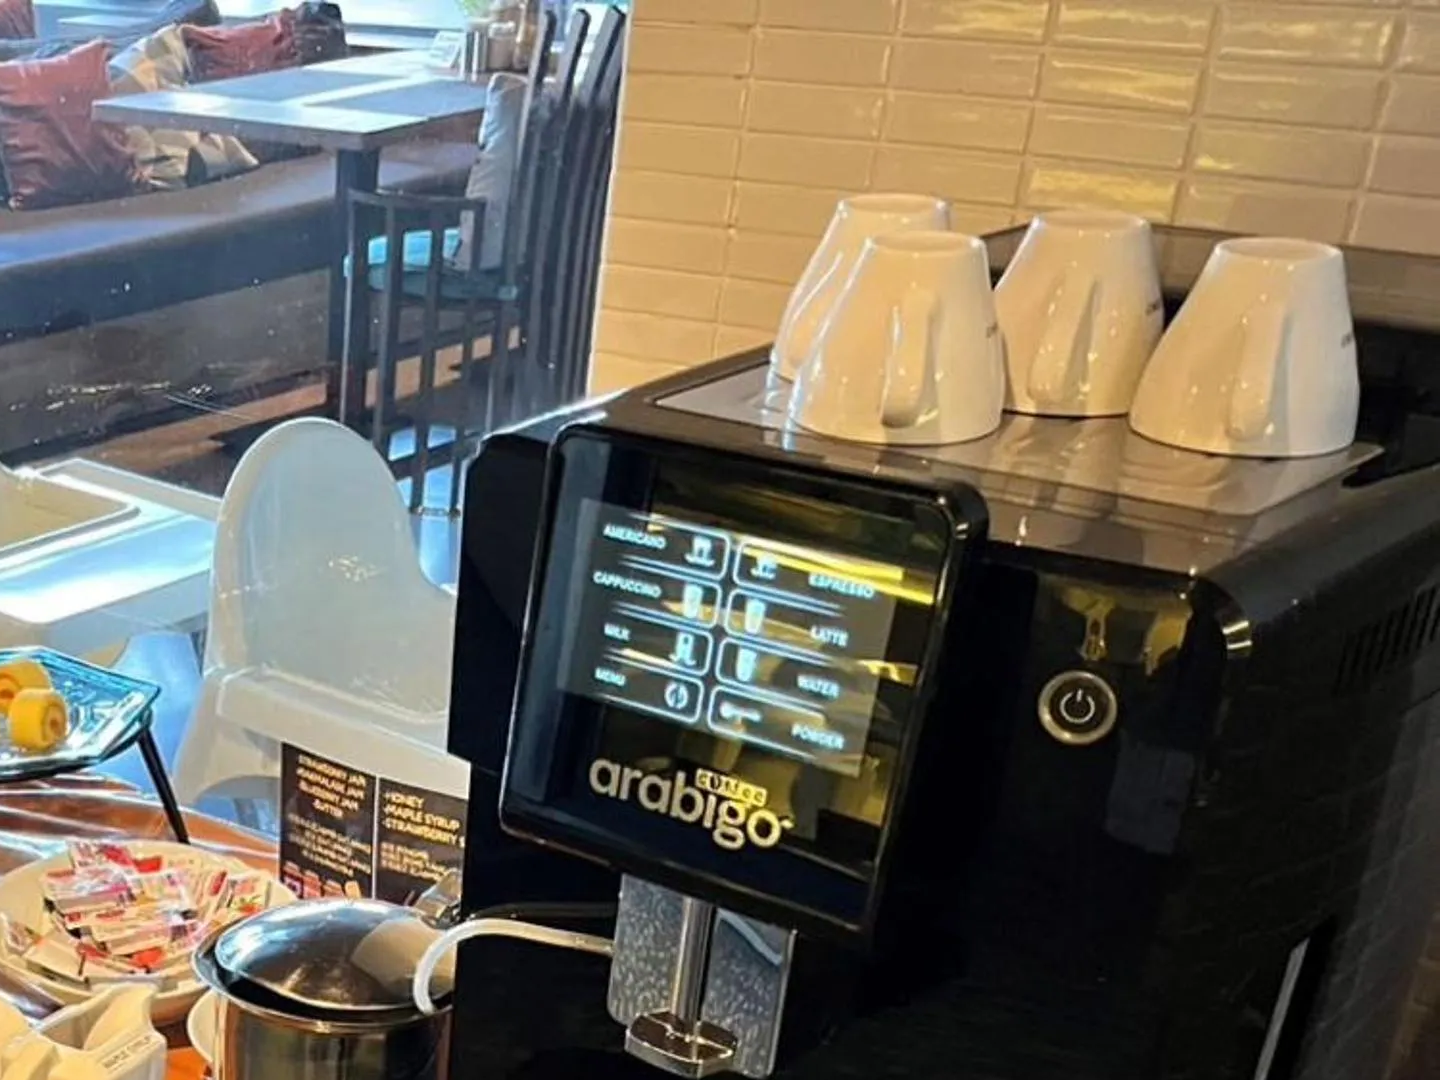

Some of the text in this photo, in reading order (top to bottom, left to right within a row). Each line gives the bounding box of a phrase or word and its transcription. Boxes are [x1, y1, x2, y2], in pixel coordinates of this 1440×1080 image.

[603, 523, 667, 549] AMERICANO
[592, 570, 661, 599] CAPPUCCINO
[808, 572, 875, 599] ESPRESSO
[603, 623, 630, 641] MILK
[810, 625, 849, 648] LATTE
[594, 667, 626, 687] MENU
[796, 674, 839, 699] WATER
[791, 723, 845, 750] POWDER
[588, 757, 783, 851] arabigo
